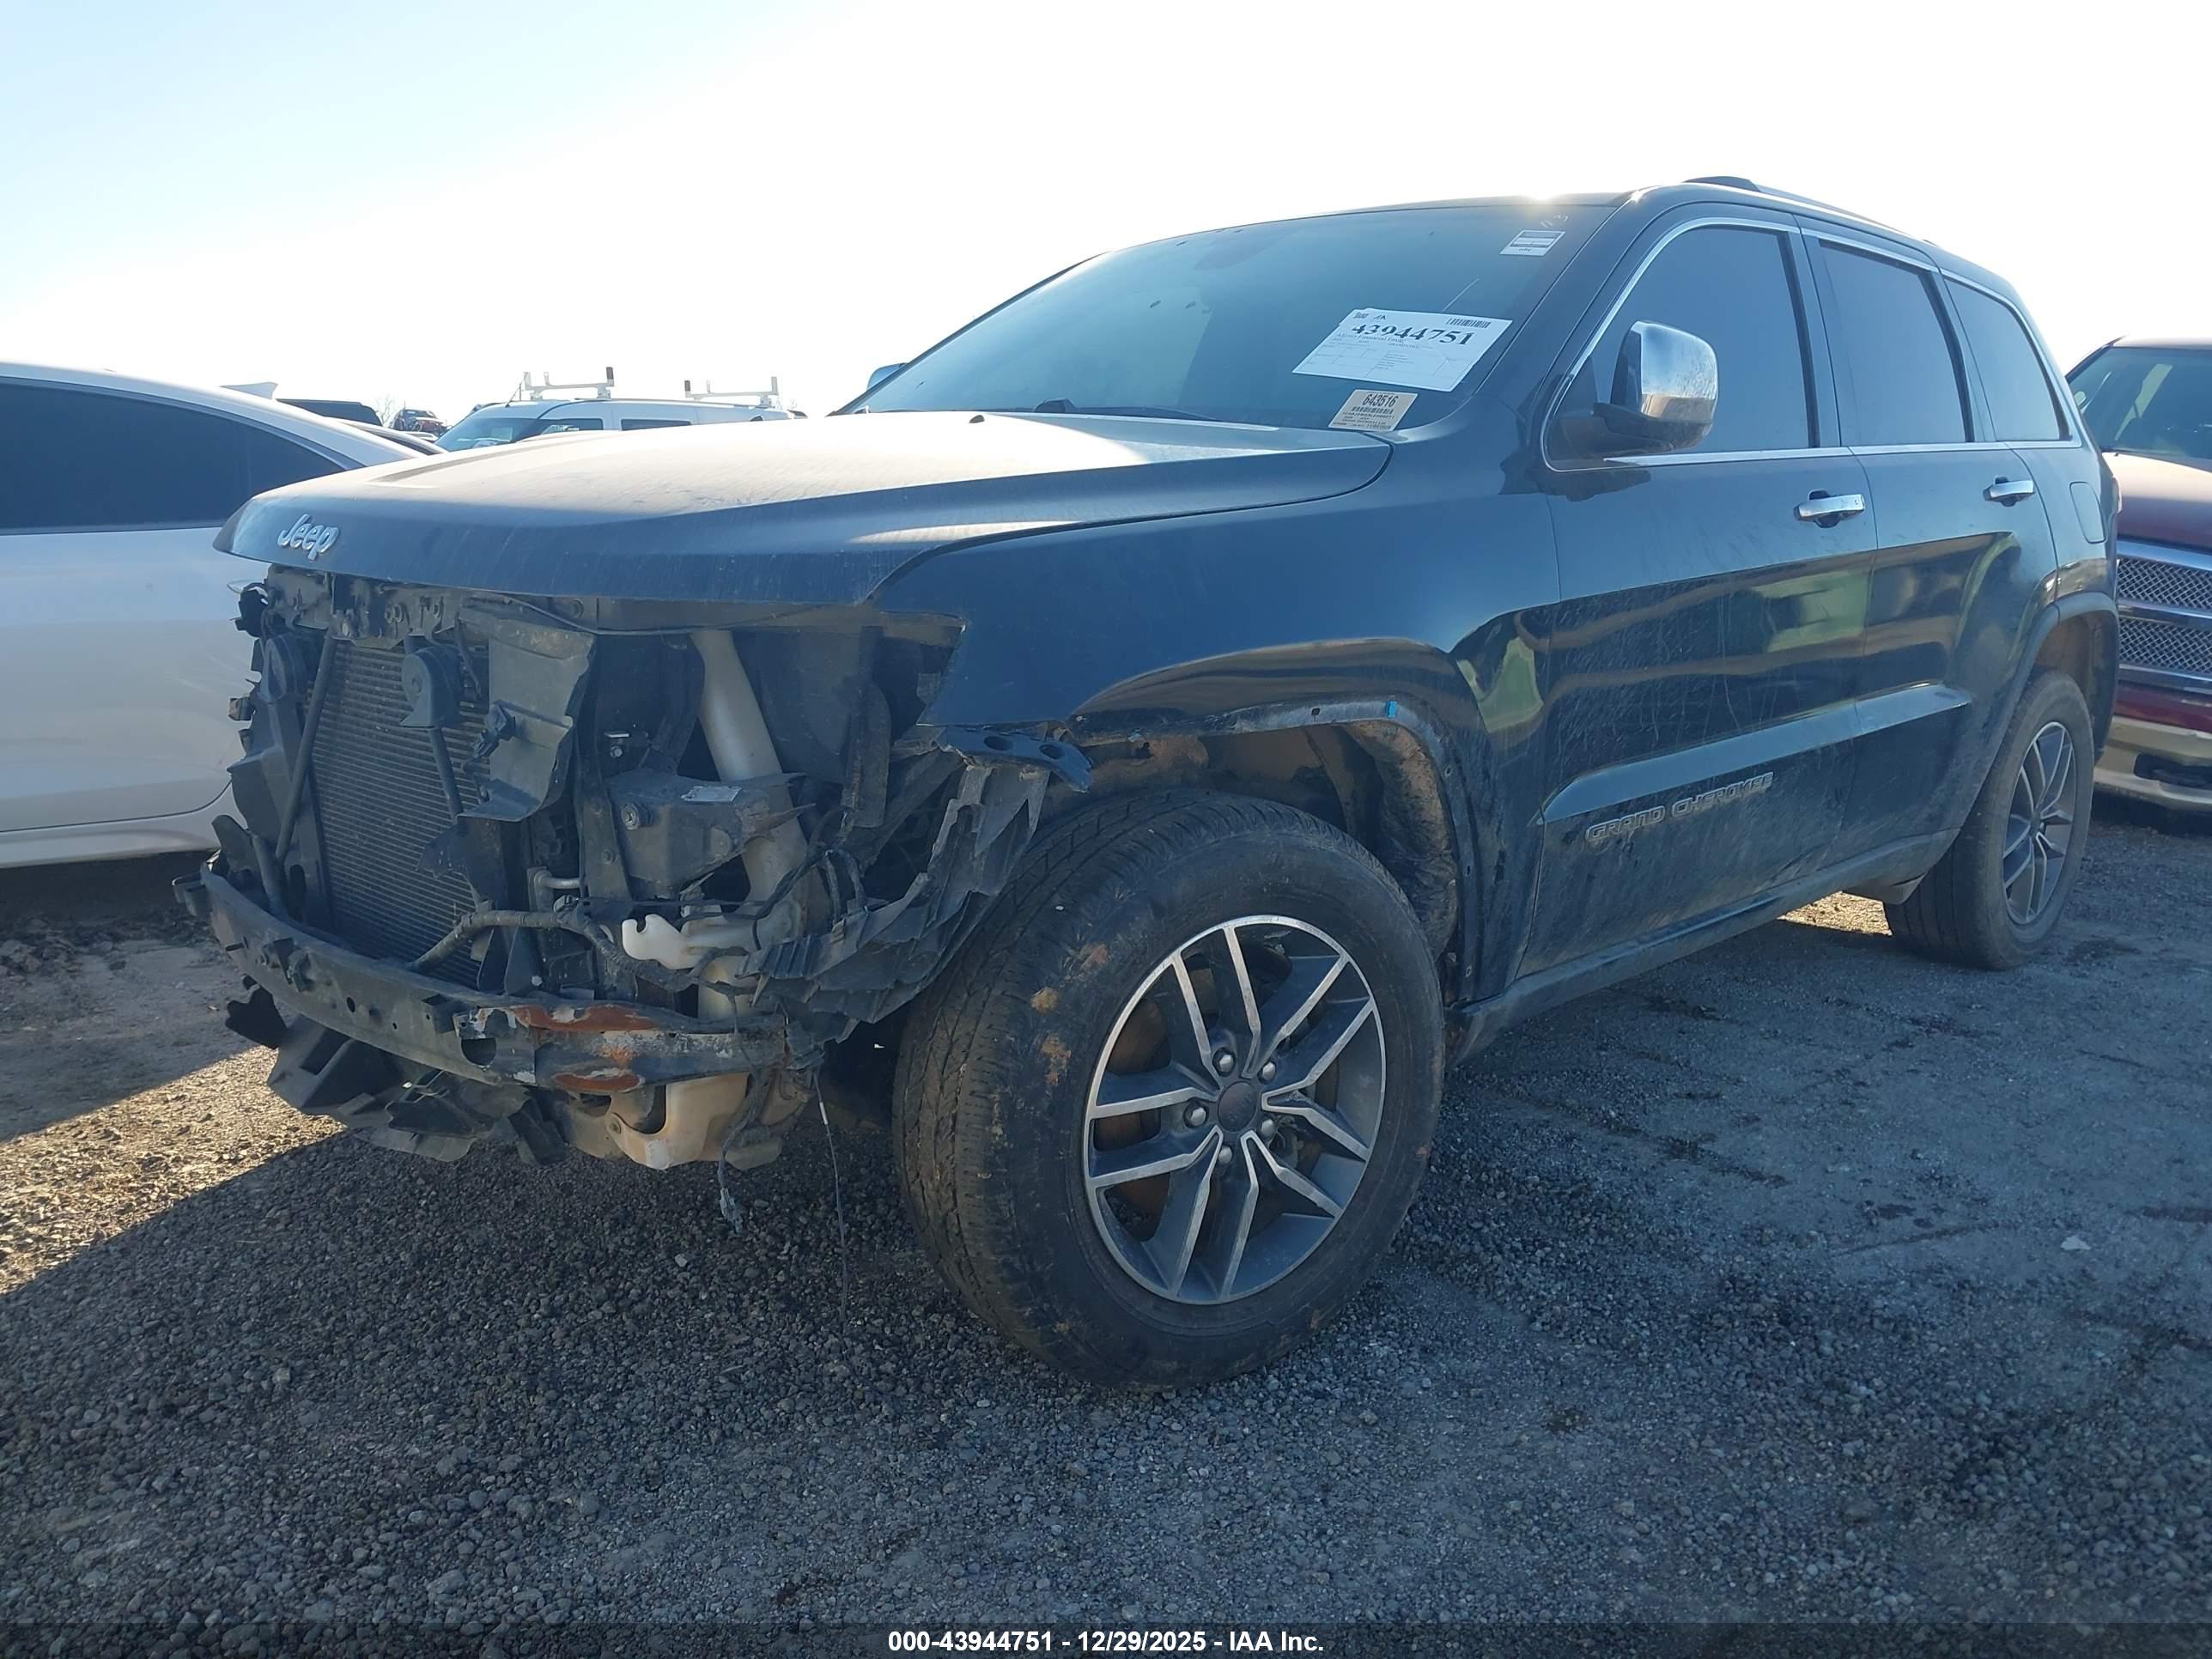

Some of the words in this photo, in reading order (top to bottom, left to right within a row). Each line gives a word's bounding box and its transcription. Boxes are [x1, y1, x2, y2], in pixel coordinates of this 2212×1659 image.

[1351, 324, 1475, 345] 43944751
[1362, 393, 1399, 408] 643516
[276, 514, 340, 561] Jeep
[1586, 805, 1666, 842] GRAND
[1672, 771, 1775, 817] CHEROKEE
